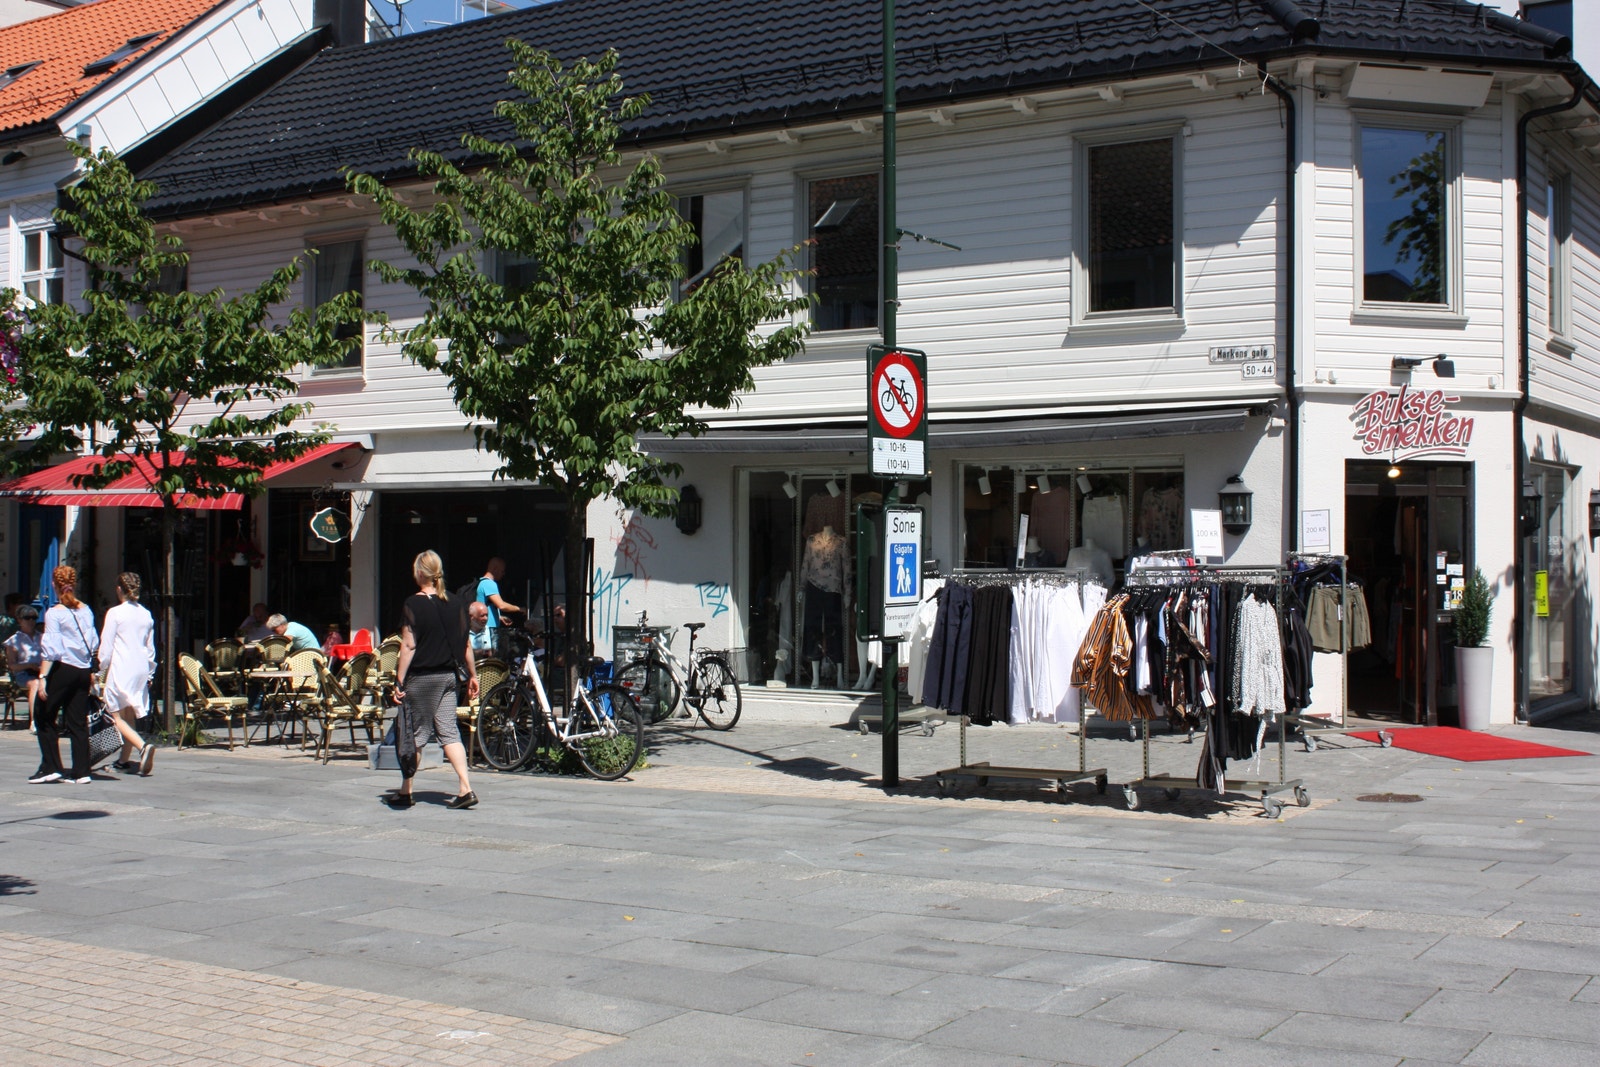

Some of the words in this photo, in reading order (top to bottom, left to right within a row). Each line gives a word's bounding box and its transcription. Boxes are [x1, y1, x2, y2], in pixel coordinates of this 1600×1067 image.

[1217, 347, 1247, 359] Markens
[1251, 347, 1268, 359] gate
[1354, 383, 1460, 435] Bukse-
[1363, 413, 1475, 454] smekken
[889, 442, 907, 453] 10-16
[887, 458, 910, 470] (10-14)
[892, 517, 916, 533] Sone
[1196, 529, 1209, 537] 100
[893, 544, 913, 556] Gågate
[1452, 589, 1463, 600] 18
